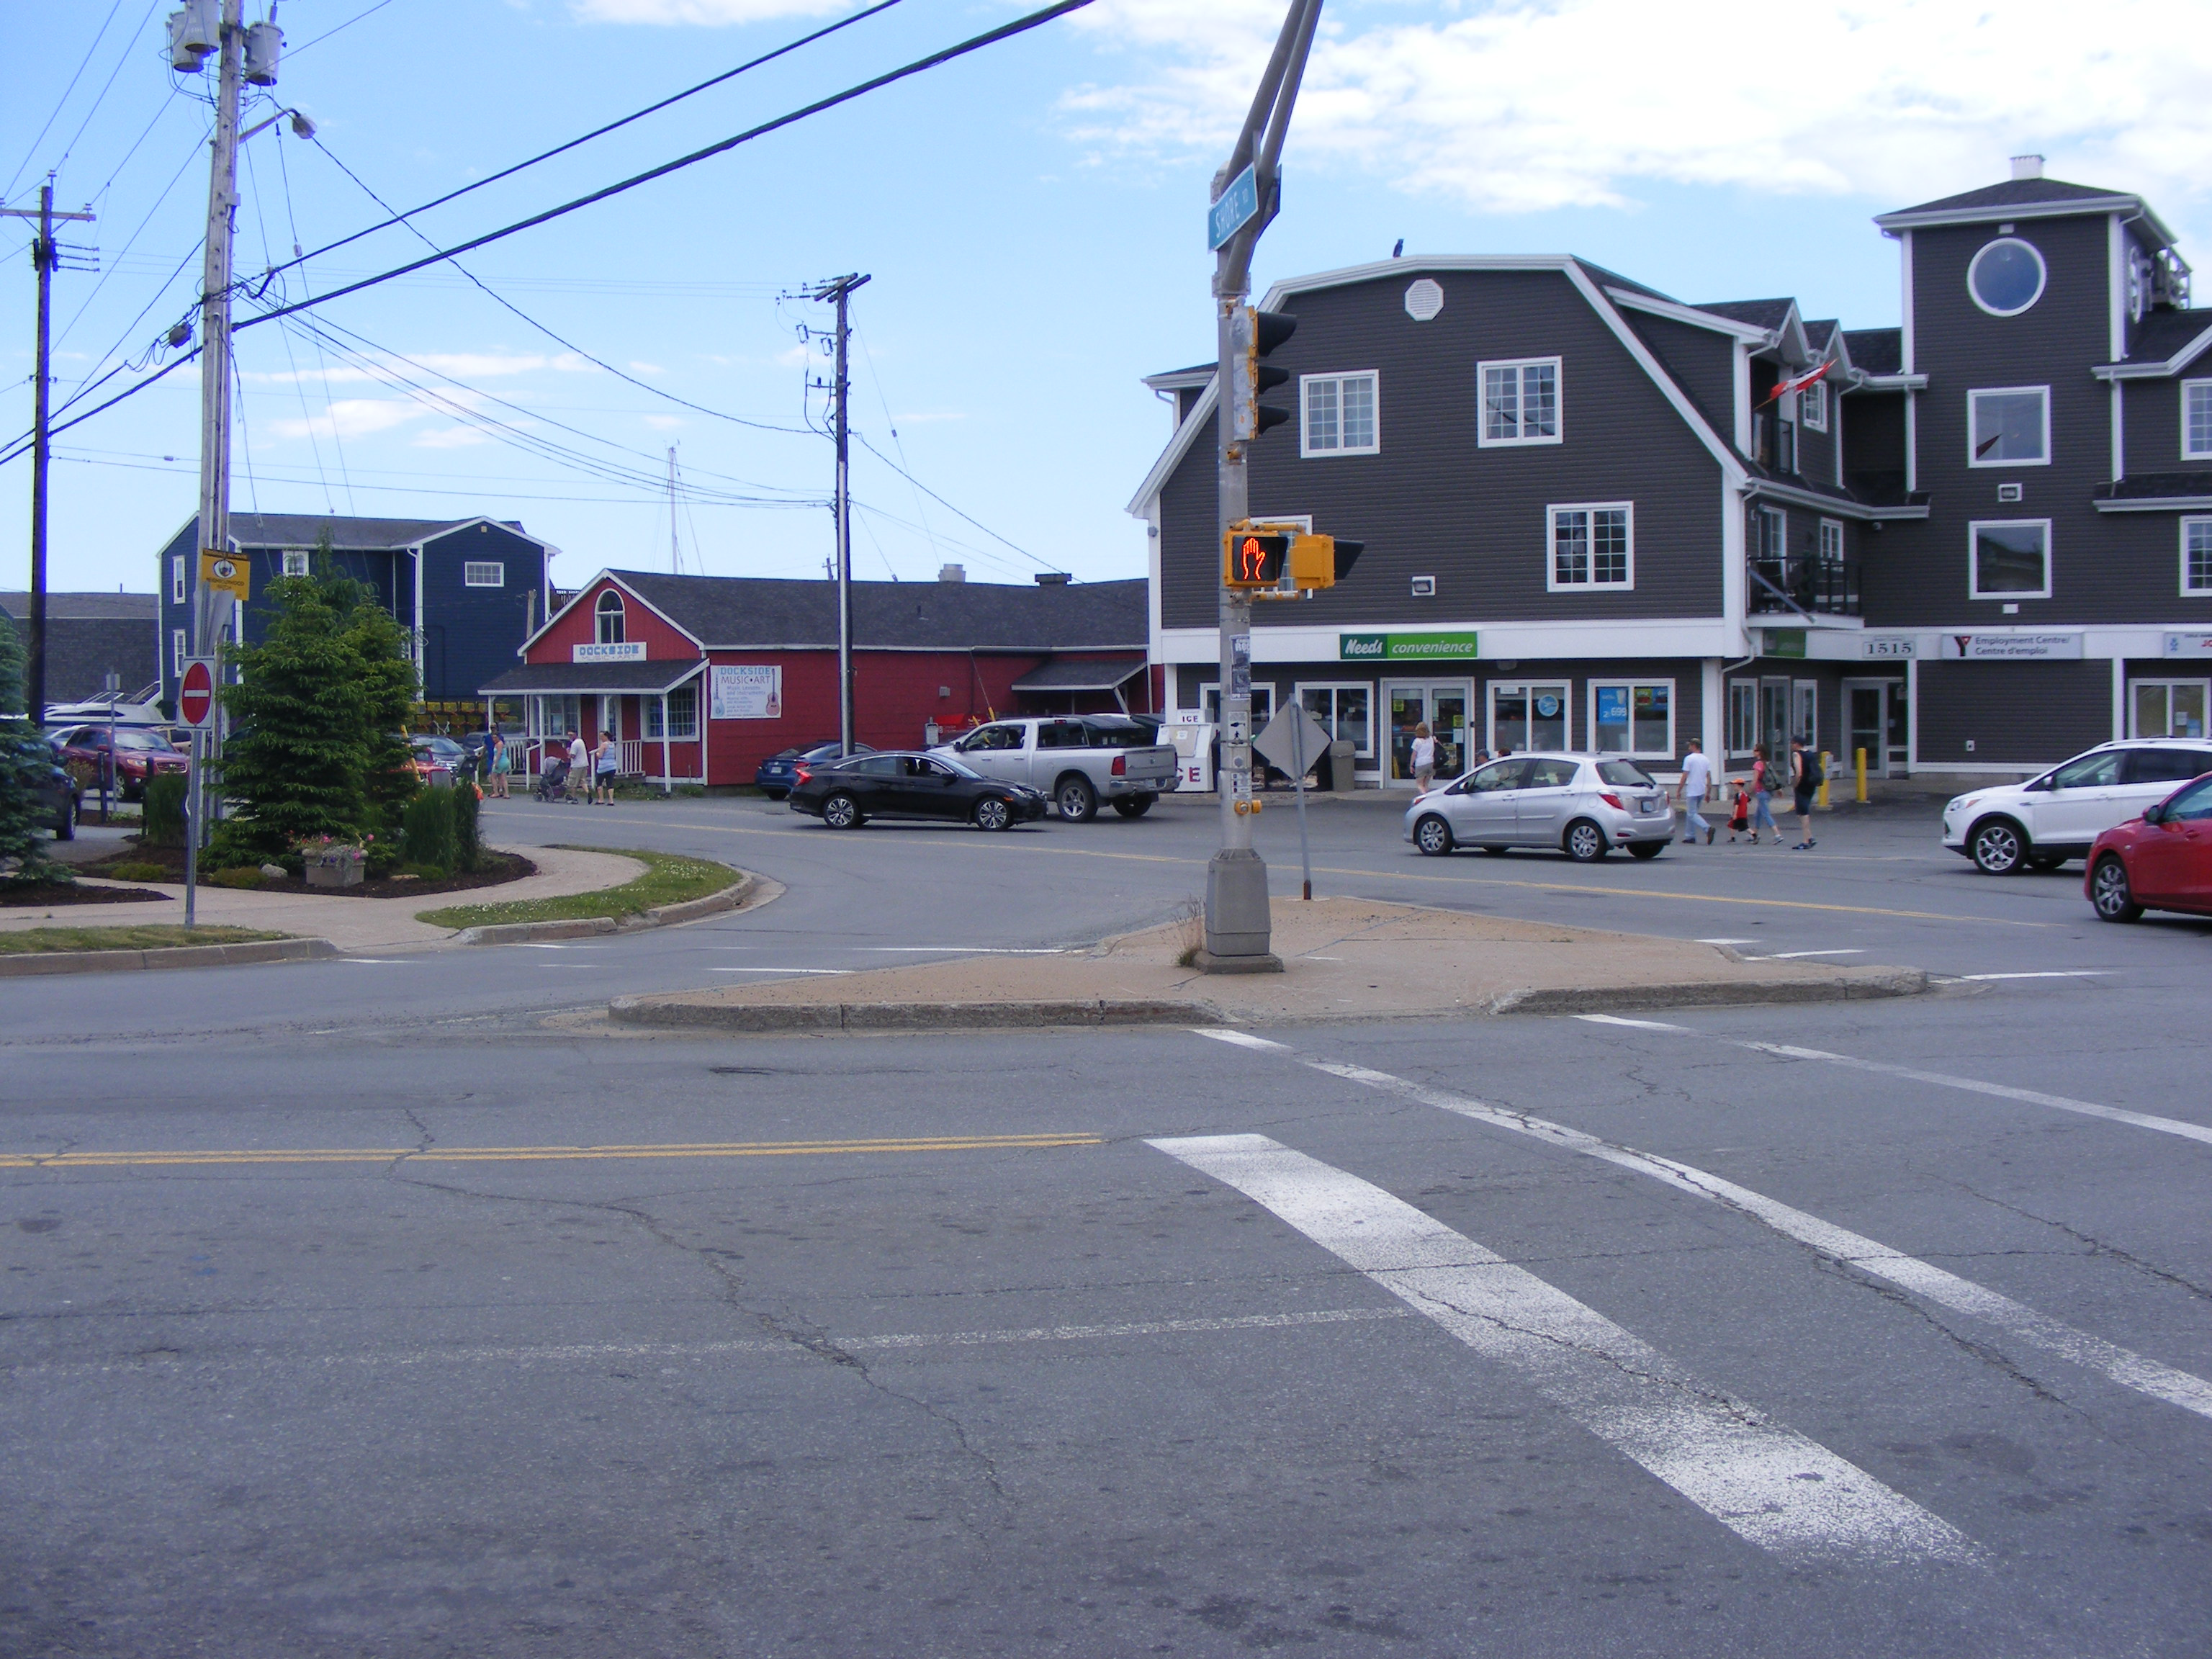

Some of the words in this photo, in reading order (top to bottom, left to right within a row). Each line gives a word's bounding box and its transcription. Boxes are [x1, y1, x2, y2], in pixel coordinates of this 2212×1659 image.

[1215, 190, 1240, 238] SHORE
[1975, 636, 2034, 646] Employment
[579, 644, 639, 656] DOCKSIDE
[1345, 639, 1383, 655] Needs
[1392, 640, 1473, 654] convenience
[1867, 643, 1912, 655] 1515
[2008, 647, 2048, 656] d'emploi
[720, 667, 771, 675] DOCKSIDE
[721, 675, 749, 684] MUSIC
[753, 675, 771, 684] ART
